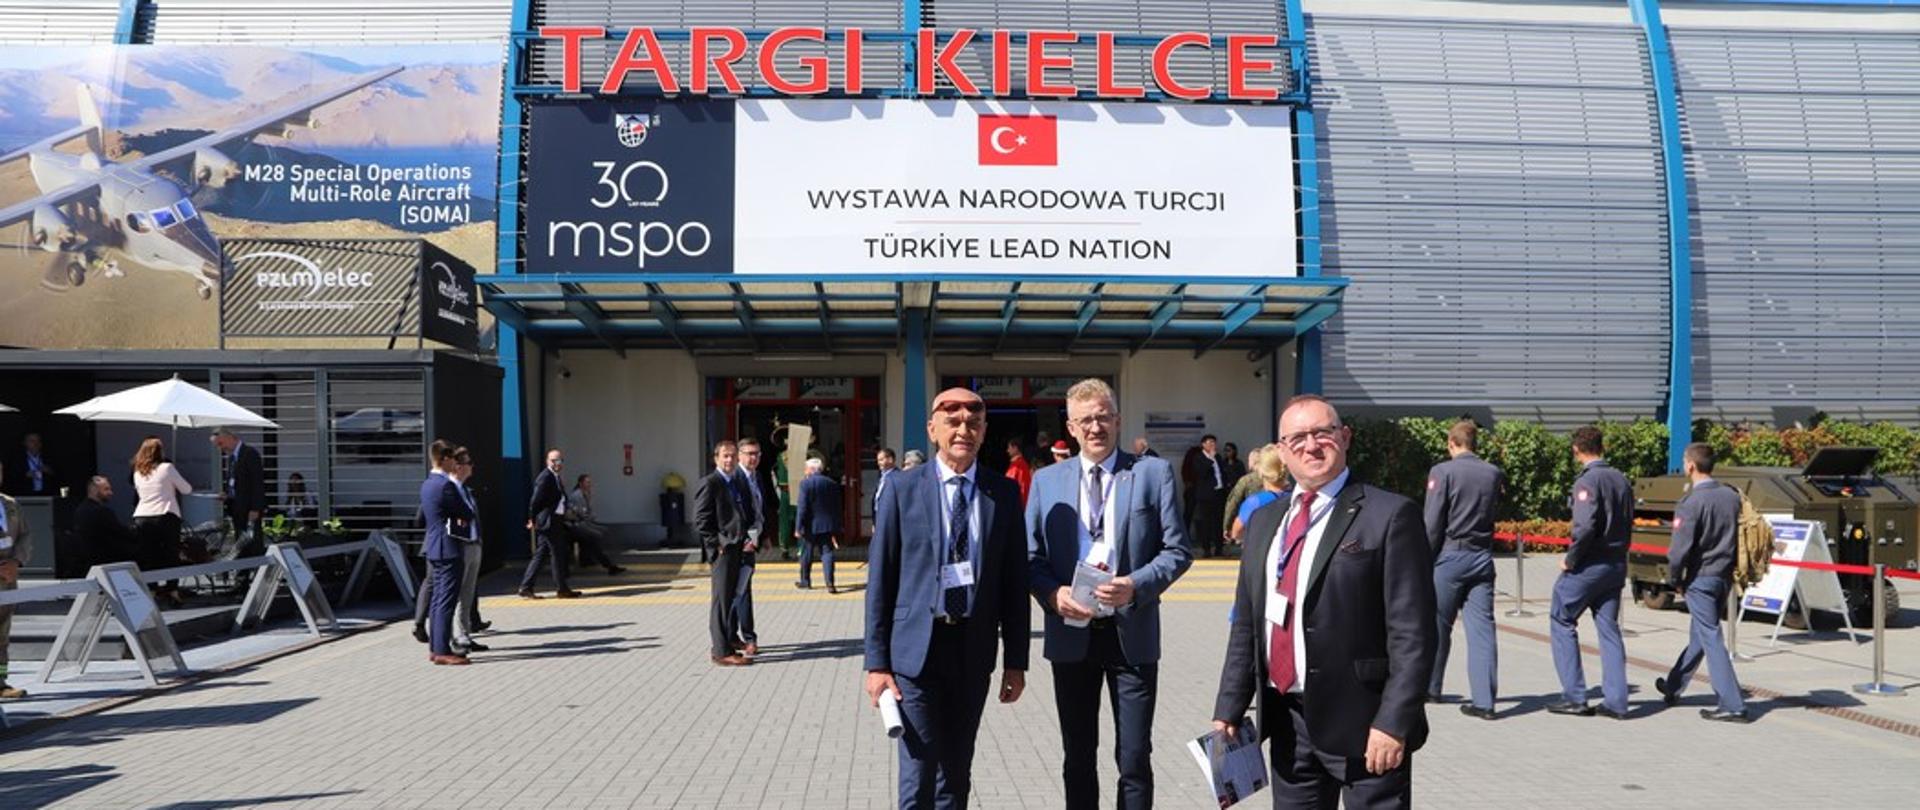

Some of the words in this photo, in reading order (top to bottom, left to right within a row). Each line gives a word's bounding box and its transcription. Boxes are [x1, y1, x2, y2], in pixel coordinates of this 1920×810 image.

[539, 26, 864, 95] TARGI
[917, 28, 1280, 100] KIELCE
[244, 164, 285, 182] M28
[290, 163, 361, 187] Special
[367, 163, 472, 187] Operations
[590, 161, 669, 208] 30
[290, 183, 392, 202] Multi-Role
[397, 183, 472, 201] Aircraft
[807, 189, 950, 209] WYSTAWA
[959, 189, 1126, 210] NARODOWA
[1134, 190, 1226, 211] TURCJI
[401, 205, 471, 224] (SOMA)
[548, 221, 711, 268] mspo
[864, 232, 980, 258] TÜRKİYE
[990, 238, 1061, 259] LEAD
[1069, 239, 1172, 260] NATION
